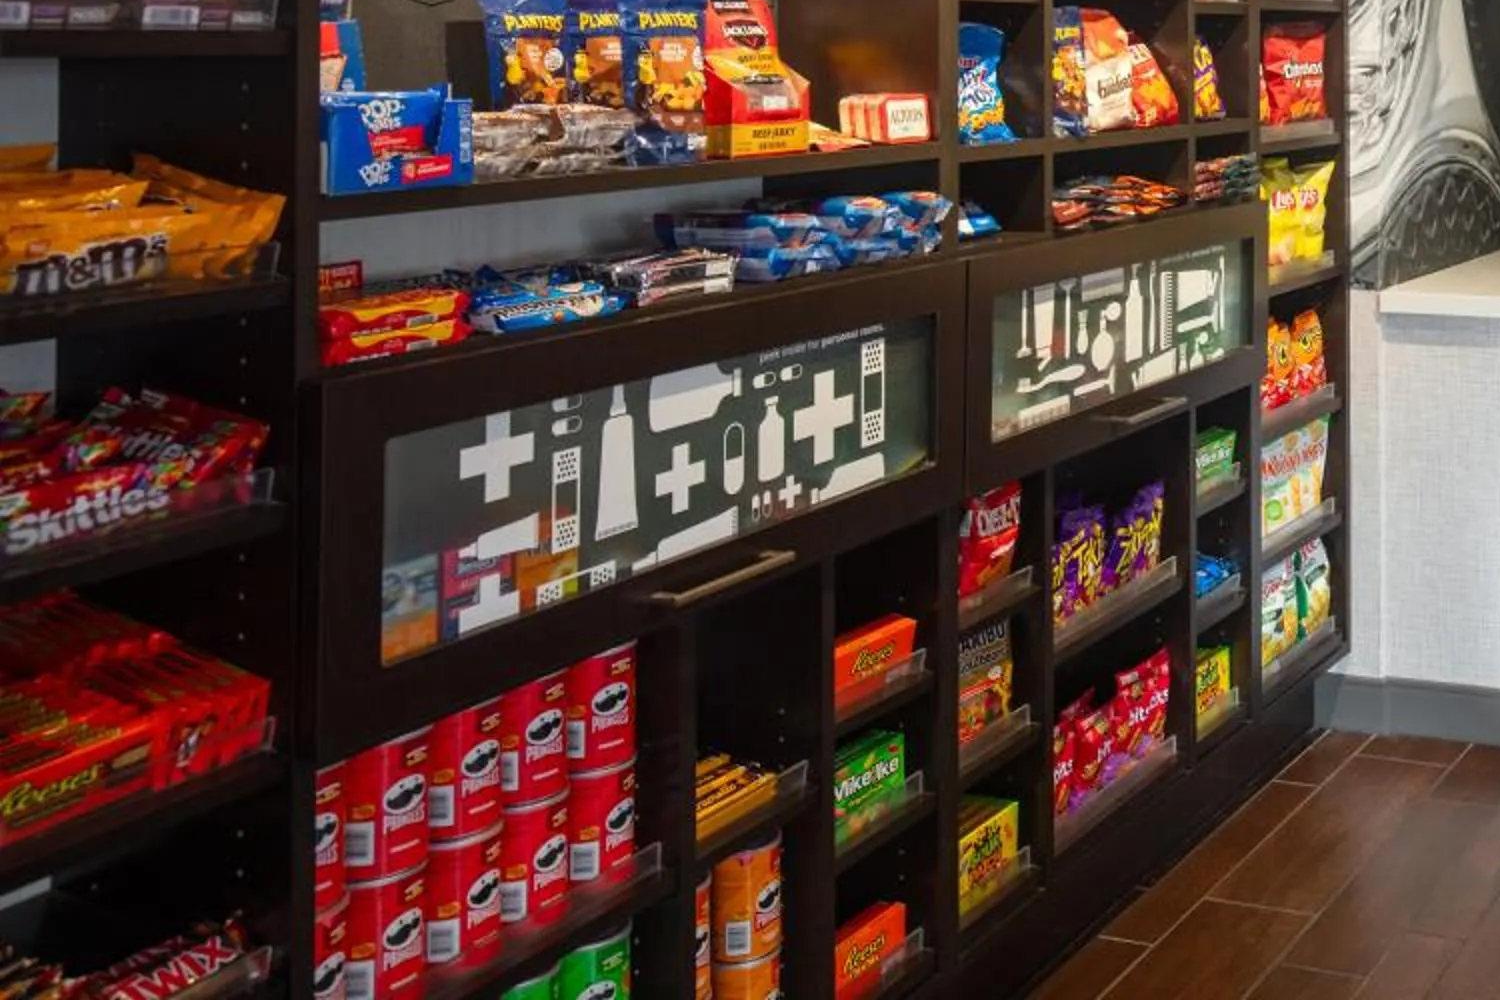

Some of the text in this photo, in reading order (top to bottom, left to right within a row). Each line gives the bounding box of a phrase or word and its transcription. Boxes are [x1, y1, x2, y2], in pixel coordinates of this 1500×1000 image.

[503, 12, 566, 32] PLANTERS
[579, 11, 622, 32] PLANT
[638, 11, 699, 30] PLANTERS
[4, 485, 171, 554] Skittles
